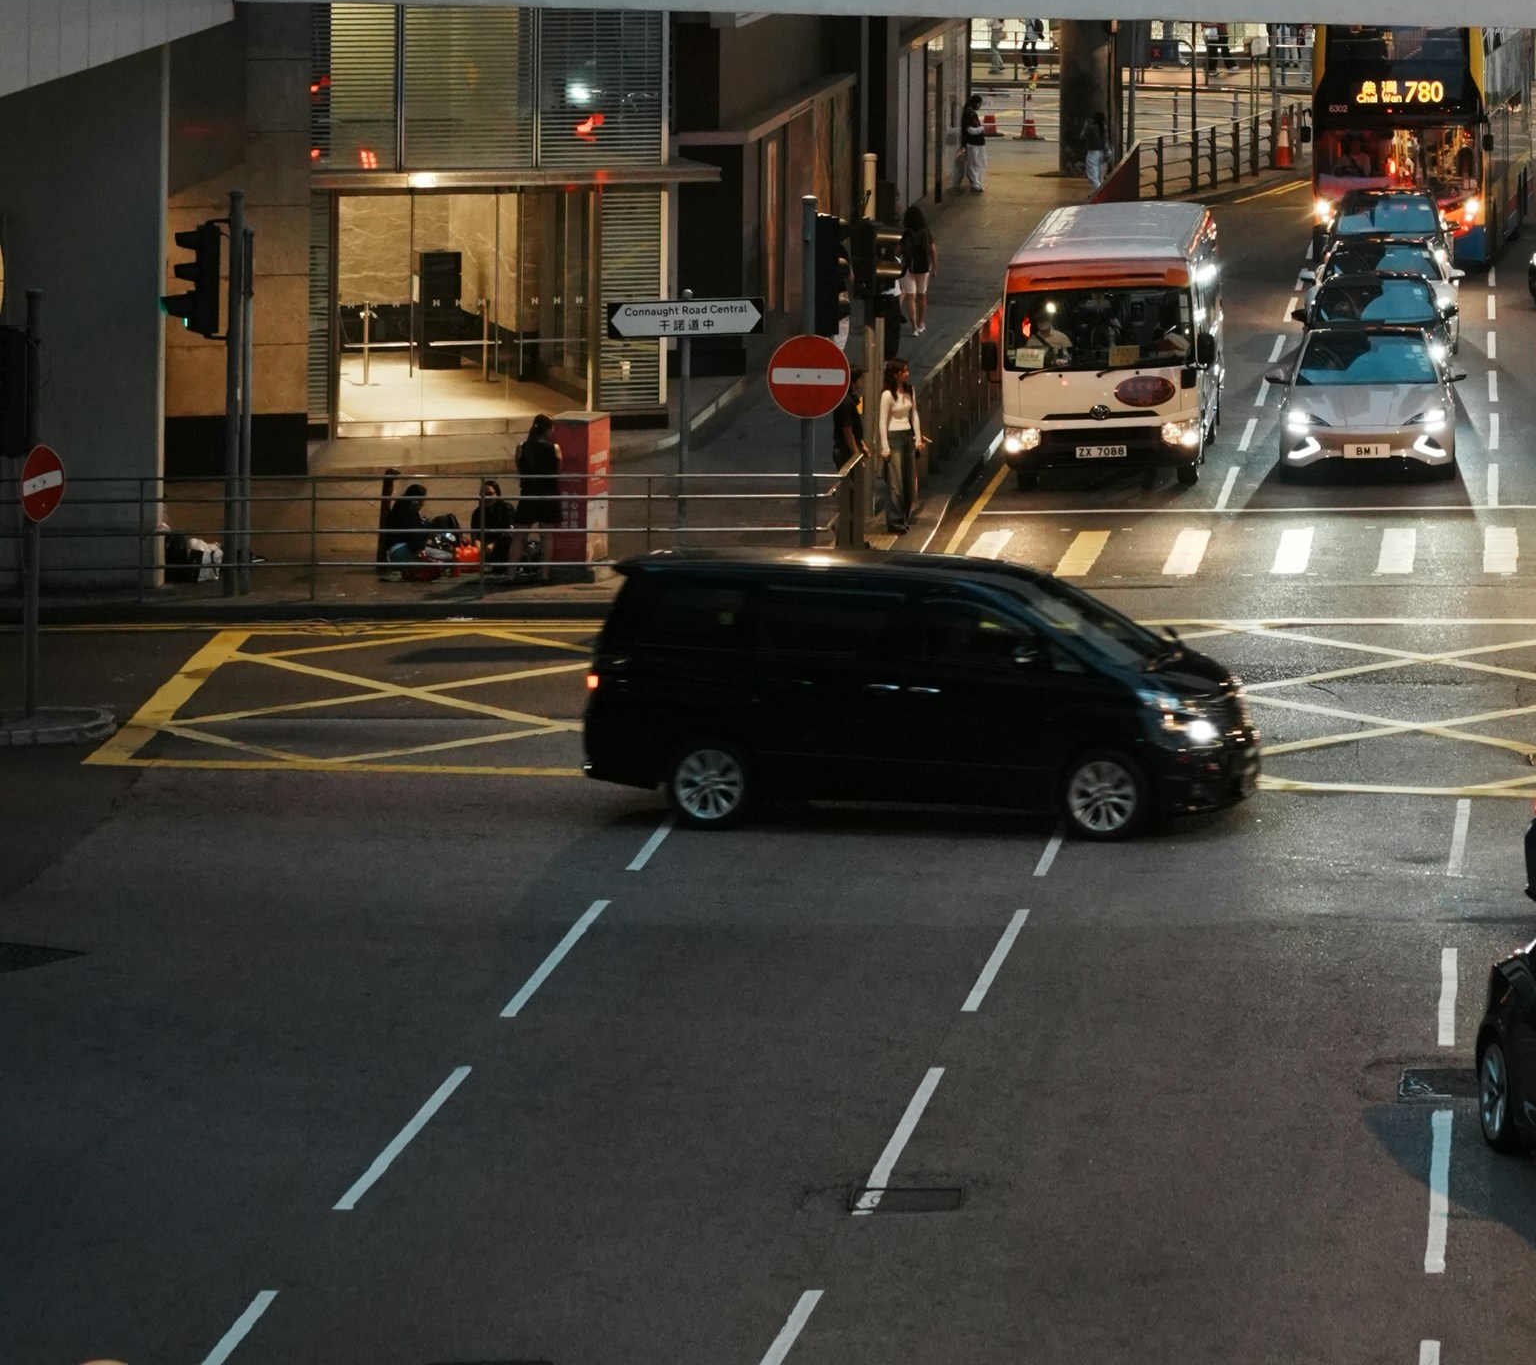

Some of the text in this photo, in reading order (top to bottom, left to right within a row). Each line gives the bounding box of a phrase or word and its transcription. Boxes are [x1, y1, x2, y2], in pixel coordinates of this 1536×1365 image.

[1405, 81, 1444, 103] 780
[1356, 93, 1402, 103] Chai Wan
[1329, 104, 1348, 112] 6302
[624, 304, 747, 317] Connaught Road Central
[659, 319, 714, 331] 干諾道中
[1078, 447, 1125, 457] ZX 7088
[1356, 447, 1370, 455] BM
